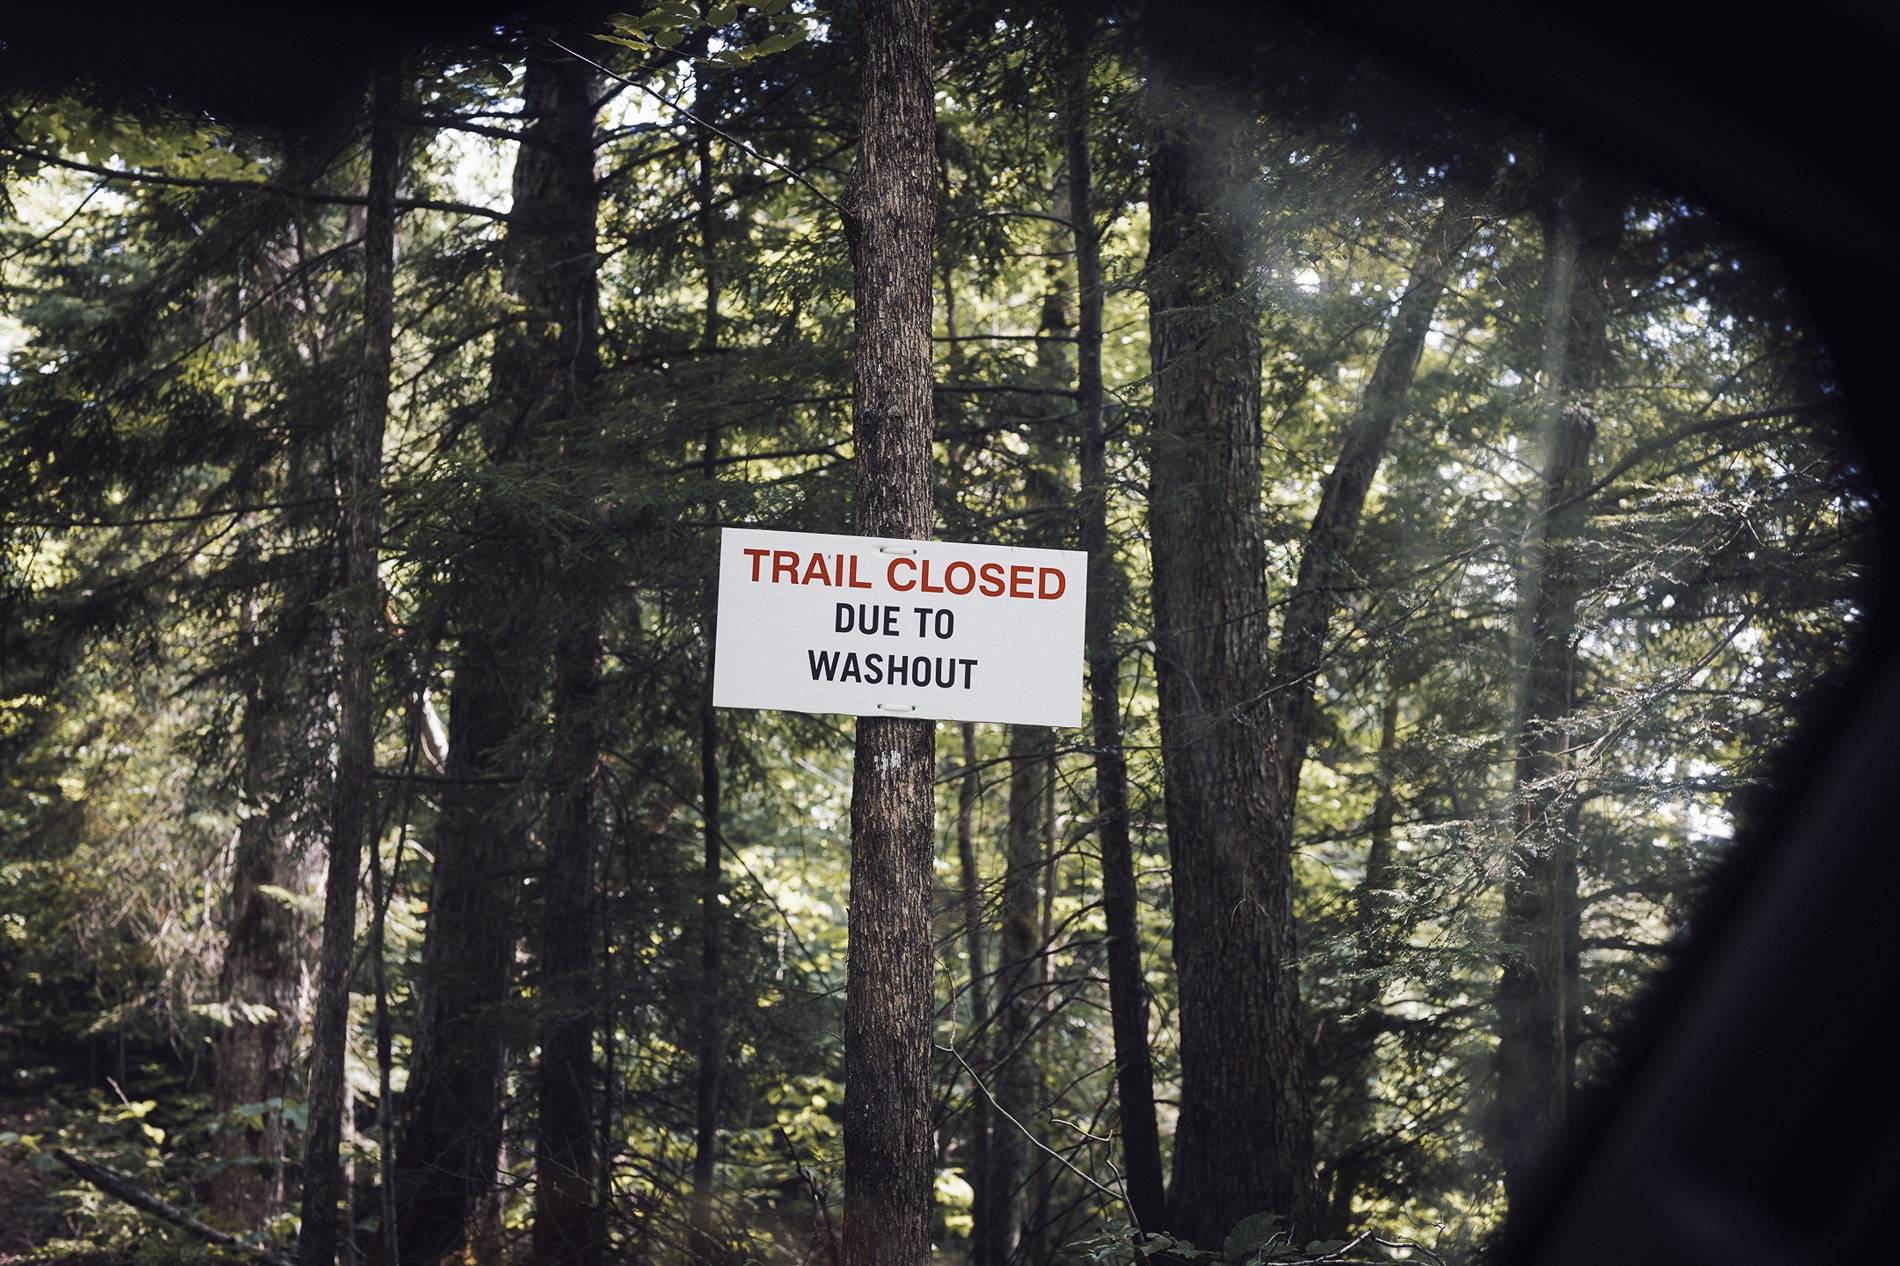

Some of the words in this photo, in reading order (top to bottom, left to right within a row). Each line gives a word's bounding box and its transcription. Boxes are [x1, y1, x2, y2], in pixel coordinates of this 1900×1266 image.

[743, 548, 873, 589] TRAIL
[886, 557, 1067, 600] CLOSED
[834, 602, 901, 637] DUE
[913, 607, 955, 640] TO
[807, 649, 978, 690] WASHOUT
